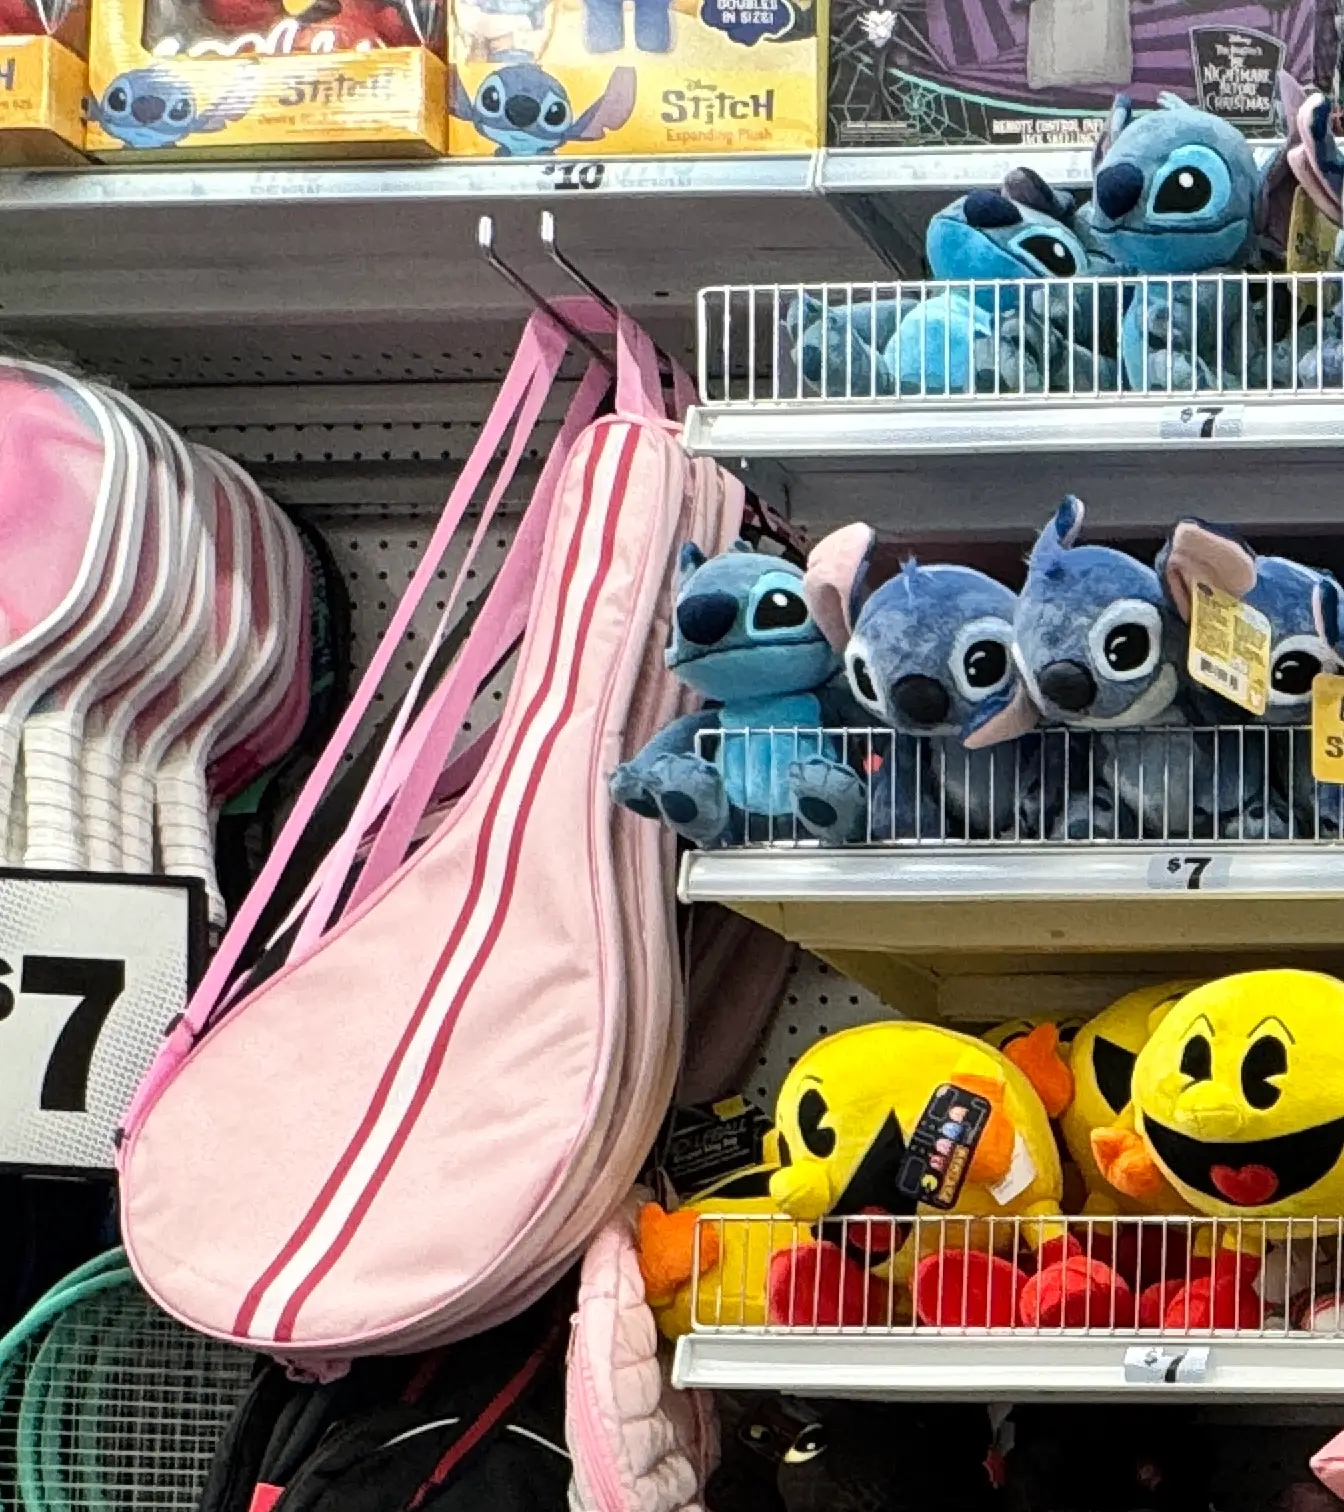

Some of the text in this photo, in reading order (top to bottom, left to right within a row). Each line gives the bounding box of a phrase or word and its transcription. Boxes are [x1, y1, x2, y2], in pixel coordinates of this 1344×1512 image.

[666, 128, 772, 146] Expanding Plush
[541, 163, 605, 190] $10
[1180, 406, 1224, 438] $7
[1166, 857, 1212, 890] $7
